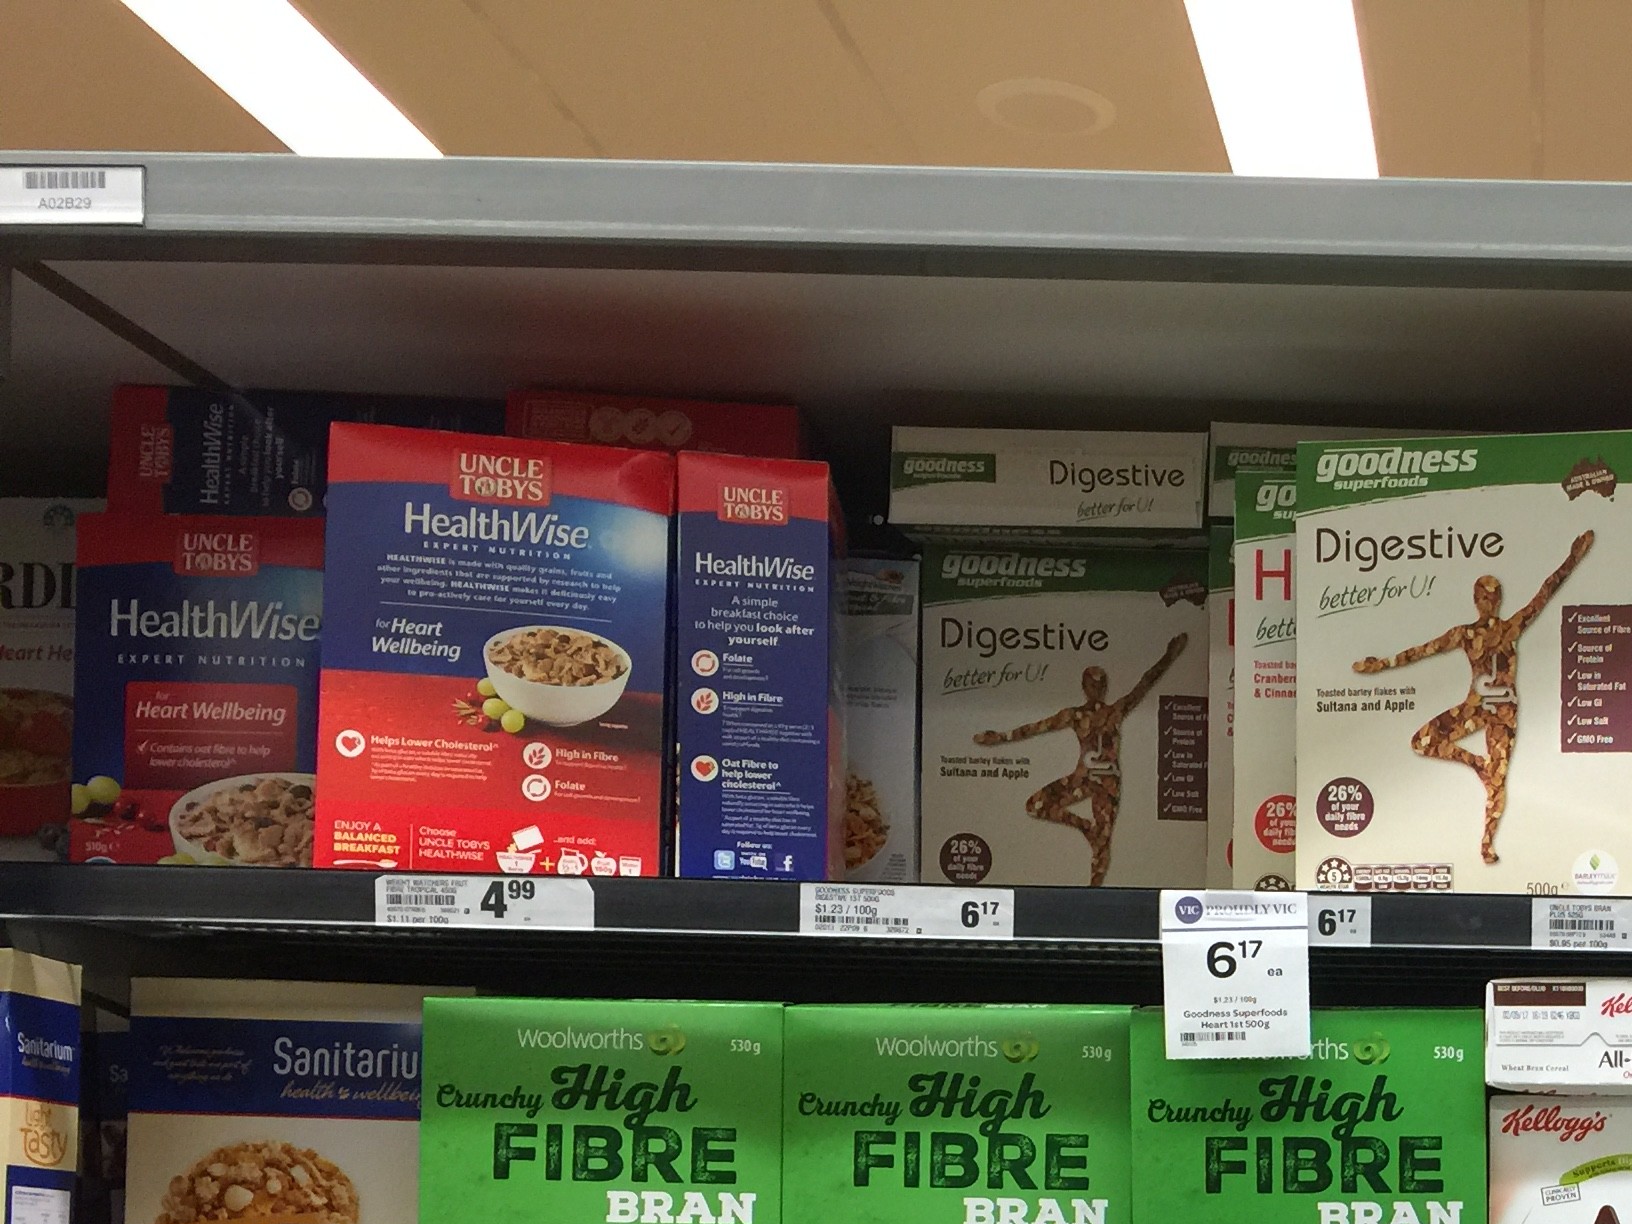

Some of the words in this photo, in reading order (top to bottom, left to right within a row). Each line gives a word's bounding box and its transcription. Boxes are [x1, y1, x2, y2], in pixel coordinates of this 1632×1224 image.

[38, 197, 91, 210] A02B29
[460, 454, 543, 478] UNCLE
[1316, 447, 1478, 482] goodness
[459, 476, 543, 500] TOBYS
[1334, 475, 1428, 490] superfoods
[404, 502, 589, 550] HealthWise
[1316, 527, 1504, 572] Digestive
[942, 554, 1087, 579] goodness
[1318, 583, 1379, 611] better
[1382, 581, 1407, 603] for
[711, 607, 761, 621] breakfast
[764, 610, 798, 621] choice
[375, 618, 391, 629] for
[392, 618, 442, 636] Heart
[695, 621, 705, 631] to
[708, 620, 730, 634] help
[733, 624, 753, 635] you
[756, 623, 780, 634] look
[782, 624, 814, 636] after
[372, 636, 461, 662] Wellbeing
[728, 634, 778, 647] yourself
[1316, 701, 1358, 712] Sultana
[1361, 700, 1382, 711] and
[1384, 698, 1415, 712] Apple
[1327, 784, 1363, 801] 26%
[1526, 882, 1559, 898] 500g
[1178, 905, 1200, 916] VIC
[1266, 968, 1284, 977] ea
[1183, 1009, 1231, 1018] Goodness
[1233, 1008, 1288, 1018] Superfoods
[1201, 1020, 1228, 1029] Heart
[1230, 1020, 1243, 1029] 1st
[1245, 1020, 1270, 1030] 500g
[517, 1027, 644, 1052] Woolworths
[730, 1038, 760, 1055] 530g
[272, 1037, 418, 1080] Sanitariu
[436, 1083, 544, 1117] Crunchy
[548, 1063, 698, 1128] High
[493, 1124, 737, 1184] FIBRE
[605, 1191, 756, 1224] BRAN
